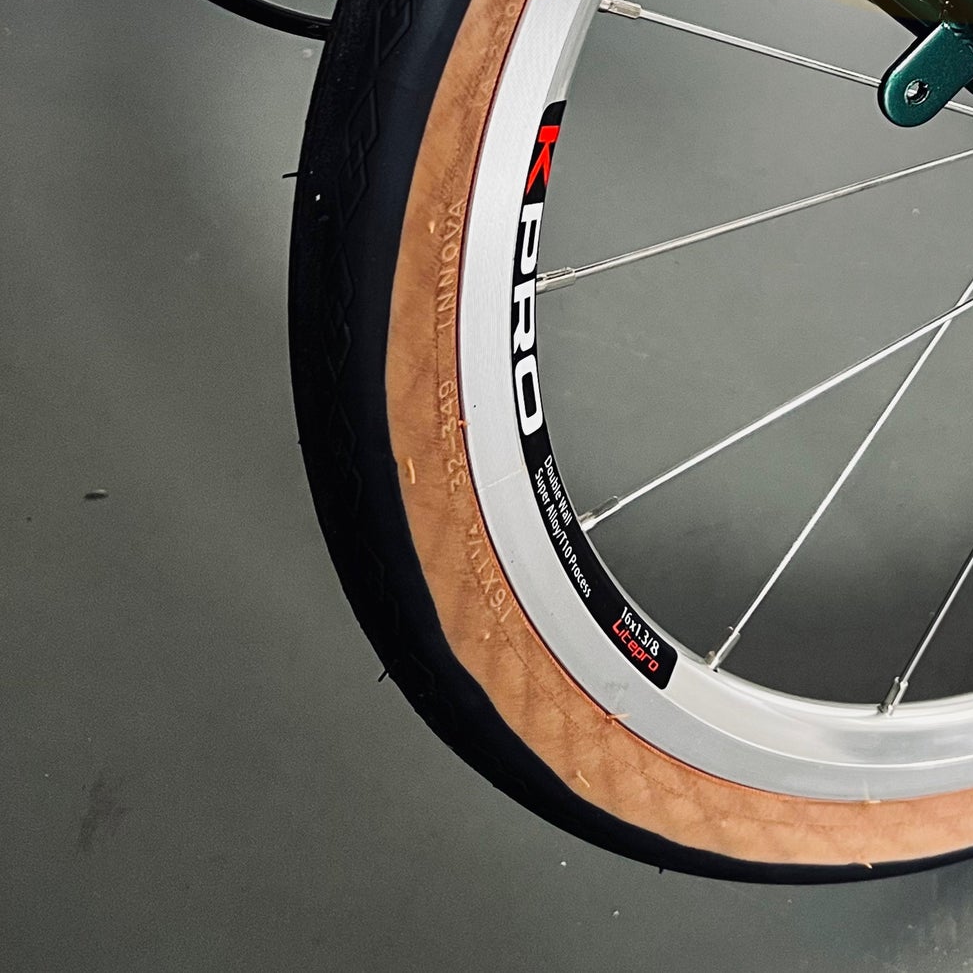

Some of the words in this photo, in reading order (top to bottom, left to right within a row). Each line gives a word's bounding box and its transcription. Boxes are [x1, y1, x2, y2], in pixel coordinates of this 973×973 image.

[436, 200, 467, 329] INNOVA
[543, 454, 562, 500] Double
[557, 495, 573, 526] Wall
[534, 467, 550, 503] Super
[568, 554, 592, 598] Process
[612, 618, 660, 672] Litepro
[620, 606, 660, 657] 16x1.3/8
